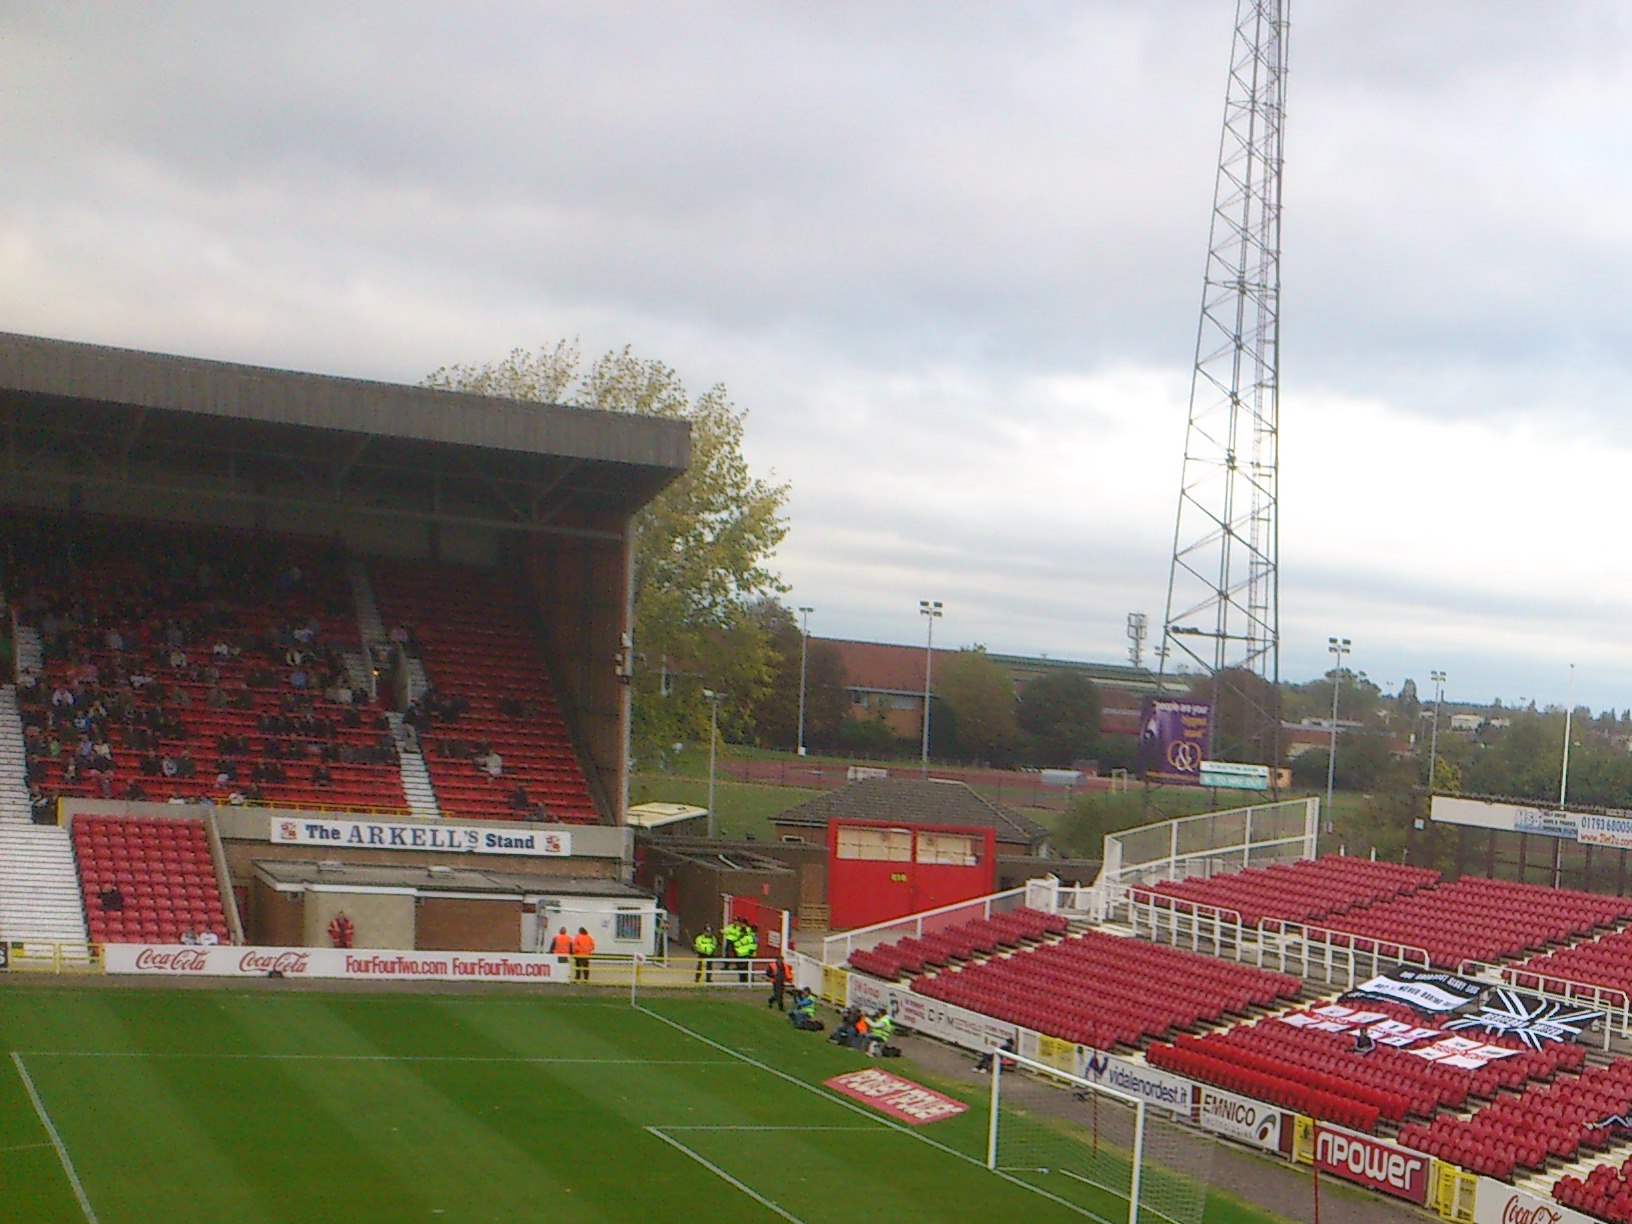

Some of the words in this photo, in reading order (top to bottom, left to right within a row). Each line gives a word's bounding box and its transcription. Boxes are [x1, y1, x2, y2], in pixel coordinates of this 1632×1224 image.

[305, 824, 341, 840] The
[349, 824, 480, 848] ARKELL'S
[485, 832, 535, 850] Stand
[1581, 817, 1605, 832] 01793
[136, 947, 209, 971] Coca-Cola
[345, 955, 448, 975] FourFourTwo.com
[452, 957, 551, 977] FourFourTwo.com
[1108, 1063, 1189, 1108] vidalenordest.it
[1202, 1093, 1256, 1127] EMNICO
[1316, 1130, 1421, 1191] npower
